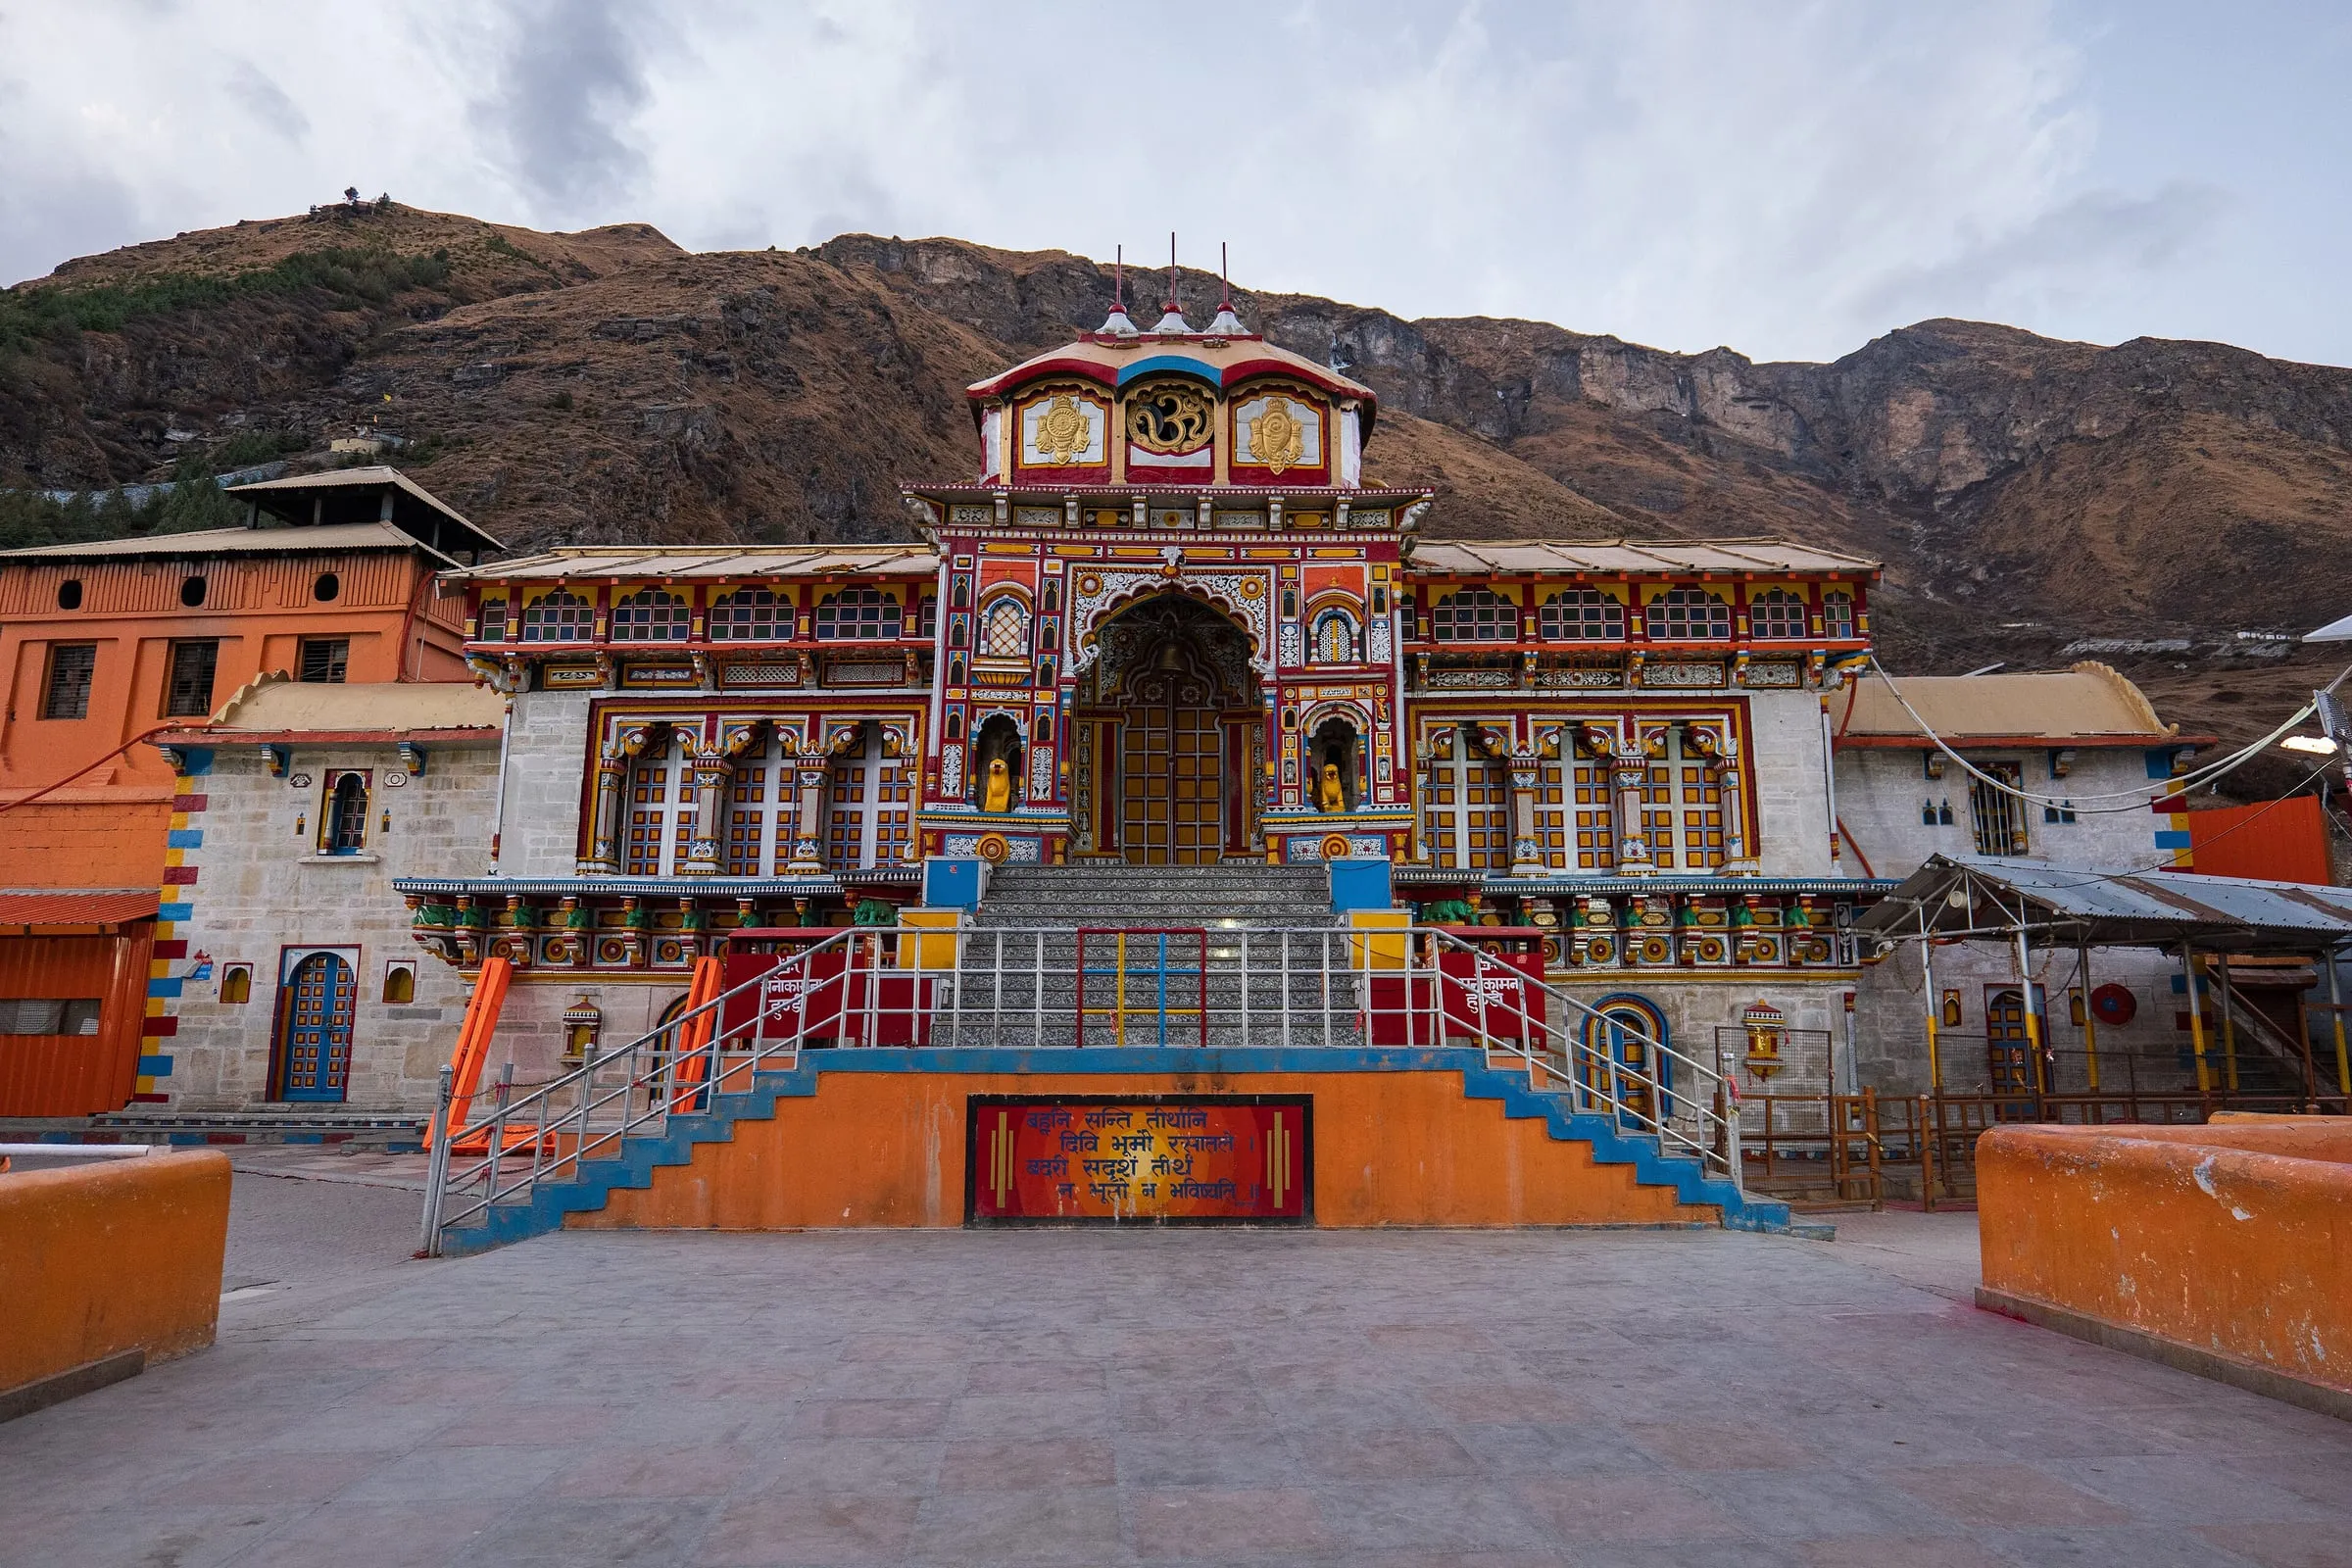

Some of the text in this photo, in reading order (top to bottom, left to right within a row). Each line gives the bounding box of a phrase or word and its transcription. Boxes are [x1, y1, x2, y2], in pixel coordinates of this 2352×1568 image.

[1085, 1105, 1133, 1130] सन्ति
[1146, 1105, 1207, 1130] तीर्थानि
[1059, 1129, 1100, 1154] दिवि
[1025, 1153, 1069, 1179] बदरी
[1082, 1154, 1138, 1182] सदृशं
[1057, 1183, 1075, 1200] न
[1142, 1183, 1157, 1200] न
[1170, 1177, 1237, 1200] भविष्यति
